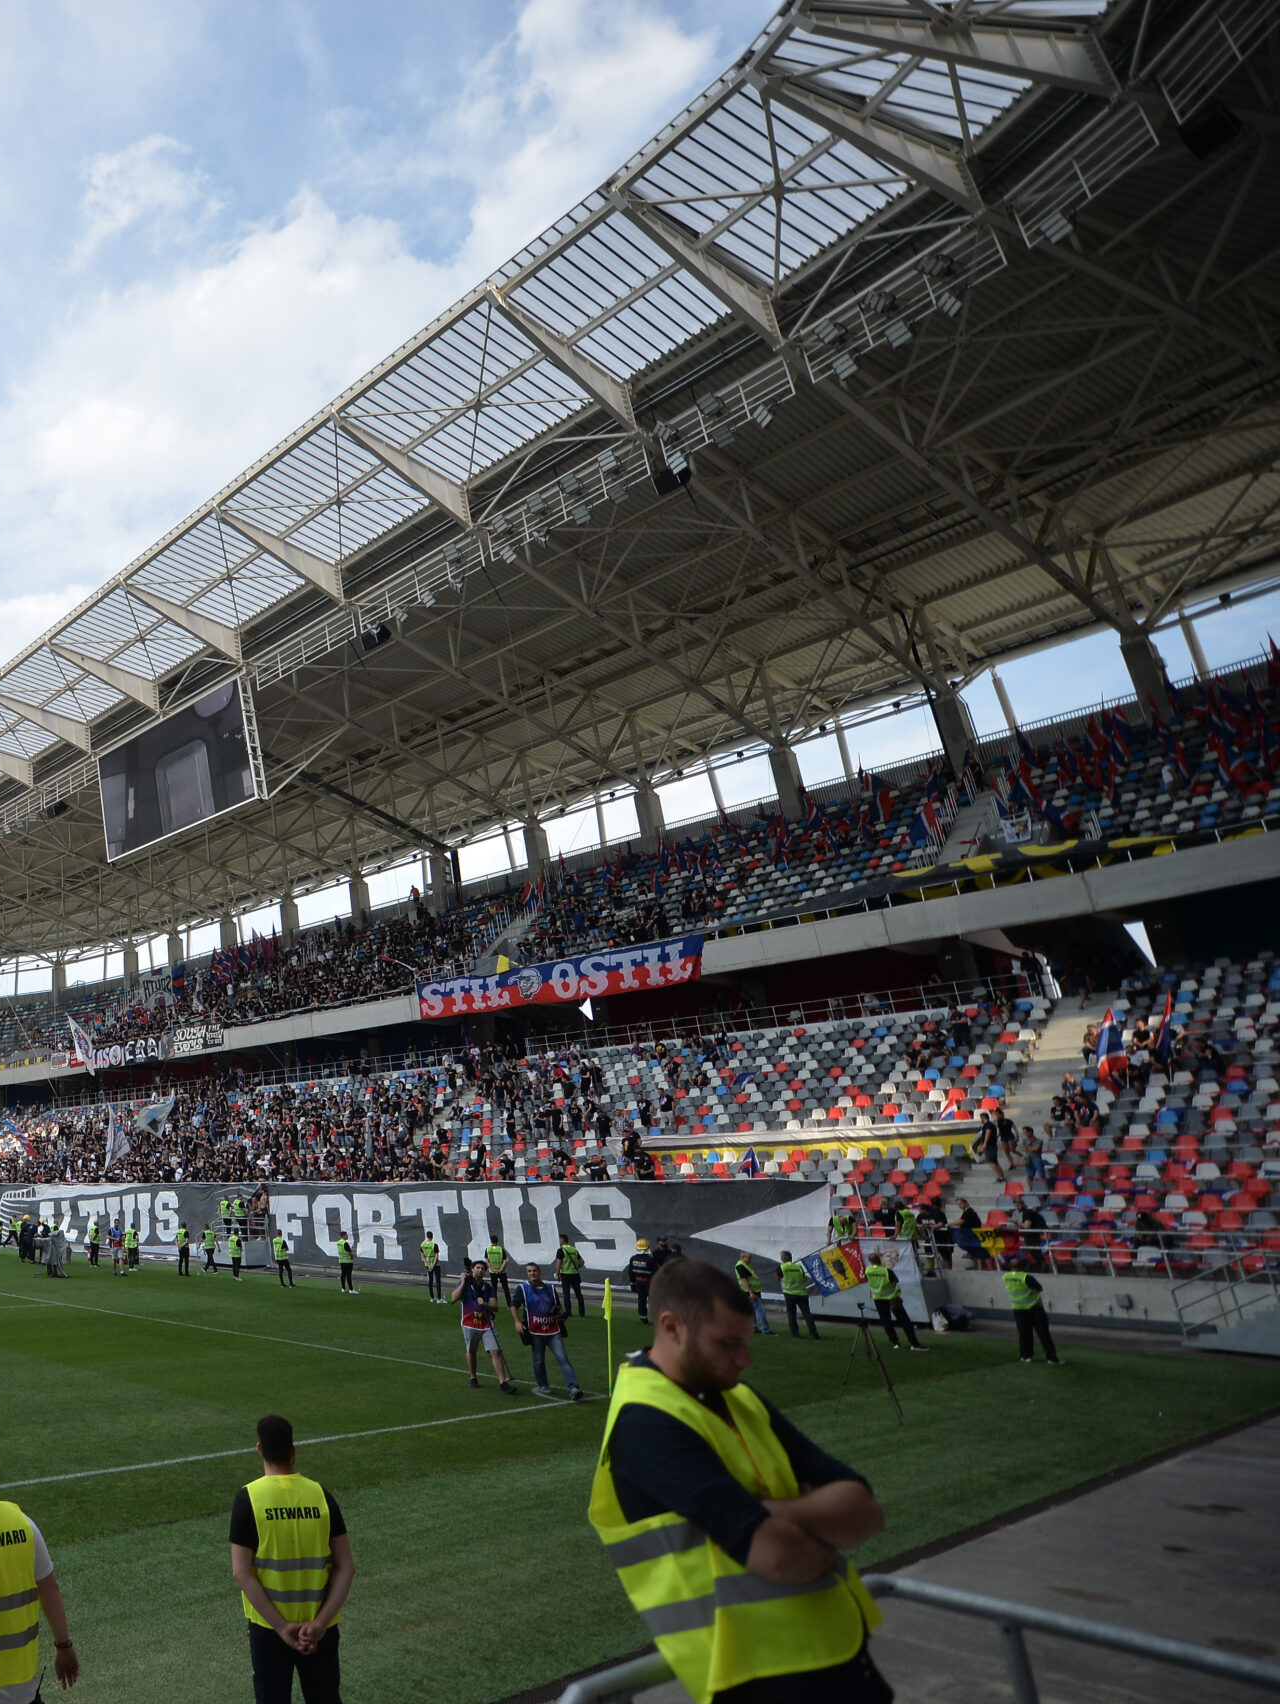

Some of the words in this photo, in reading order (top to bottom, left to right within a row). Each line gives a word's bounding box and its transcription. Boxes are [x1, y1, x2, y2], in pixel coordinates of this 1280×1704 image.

[421, 974, 511, 1017] STIL
[548, 941, 694, 999] OSTIL
[173, 1024, 207, 1042] SOUTH
[173, 1038, 204, 1053] BOYS
[275, 1185, 633, 1272] FORTIUS
[265, 1506, 321, 1521] STEWARD
